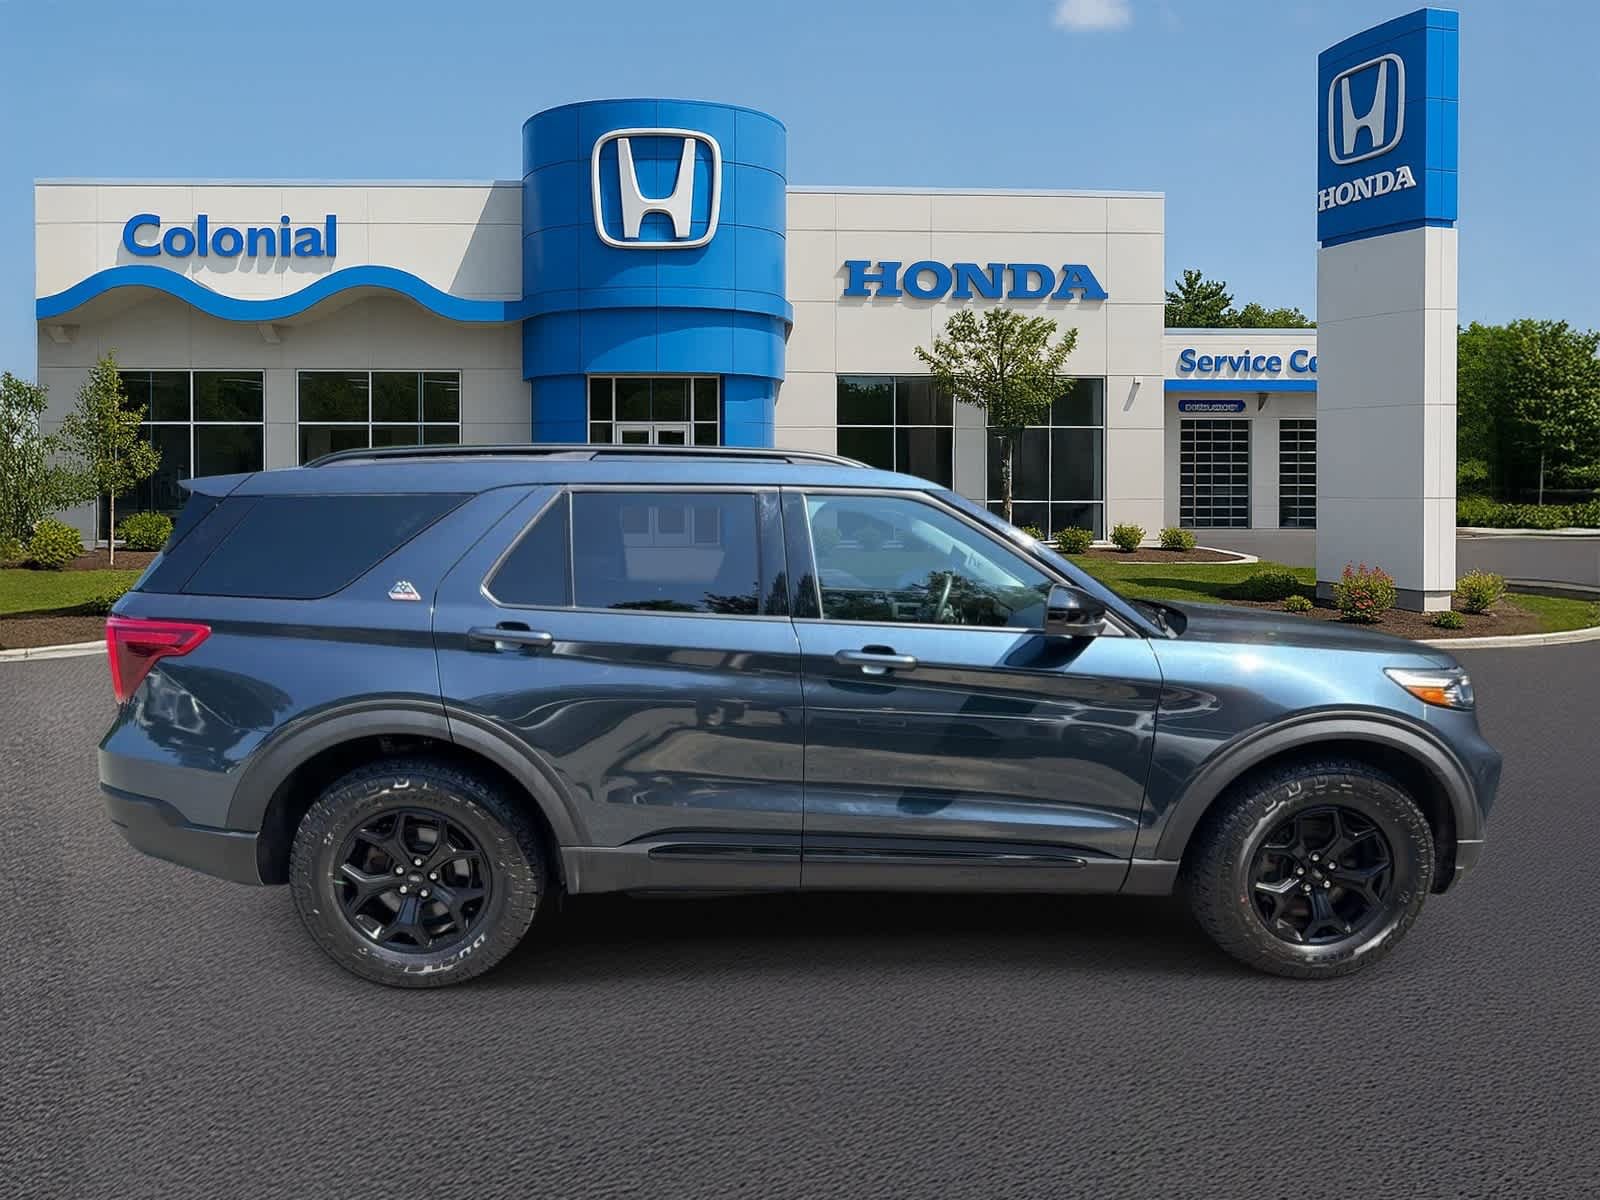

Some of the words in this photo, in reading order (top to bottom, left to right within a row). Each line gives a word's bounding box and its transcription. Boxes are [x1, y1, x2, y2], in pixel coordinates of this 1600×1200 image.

[1318, 165, 1417, 212] HONDA
[122, 213, 337, 257] Colonial
[843, 260, 1109, 301] HONDA
[1180, 348, 1282, 373] Service
